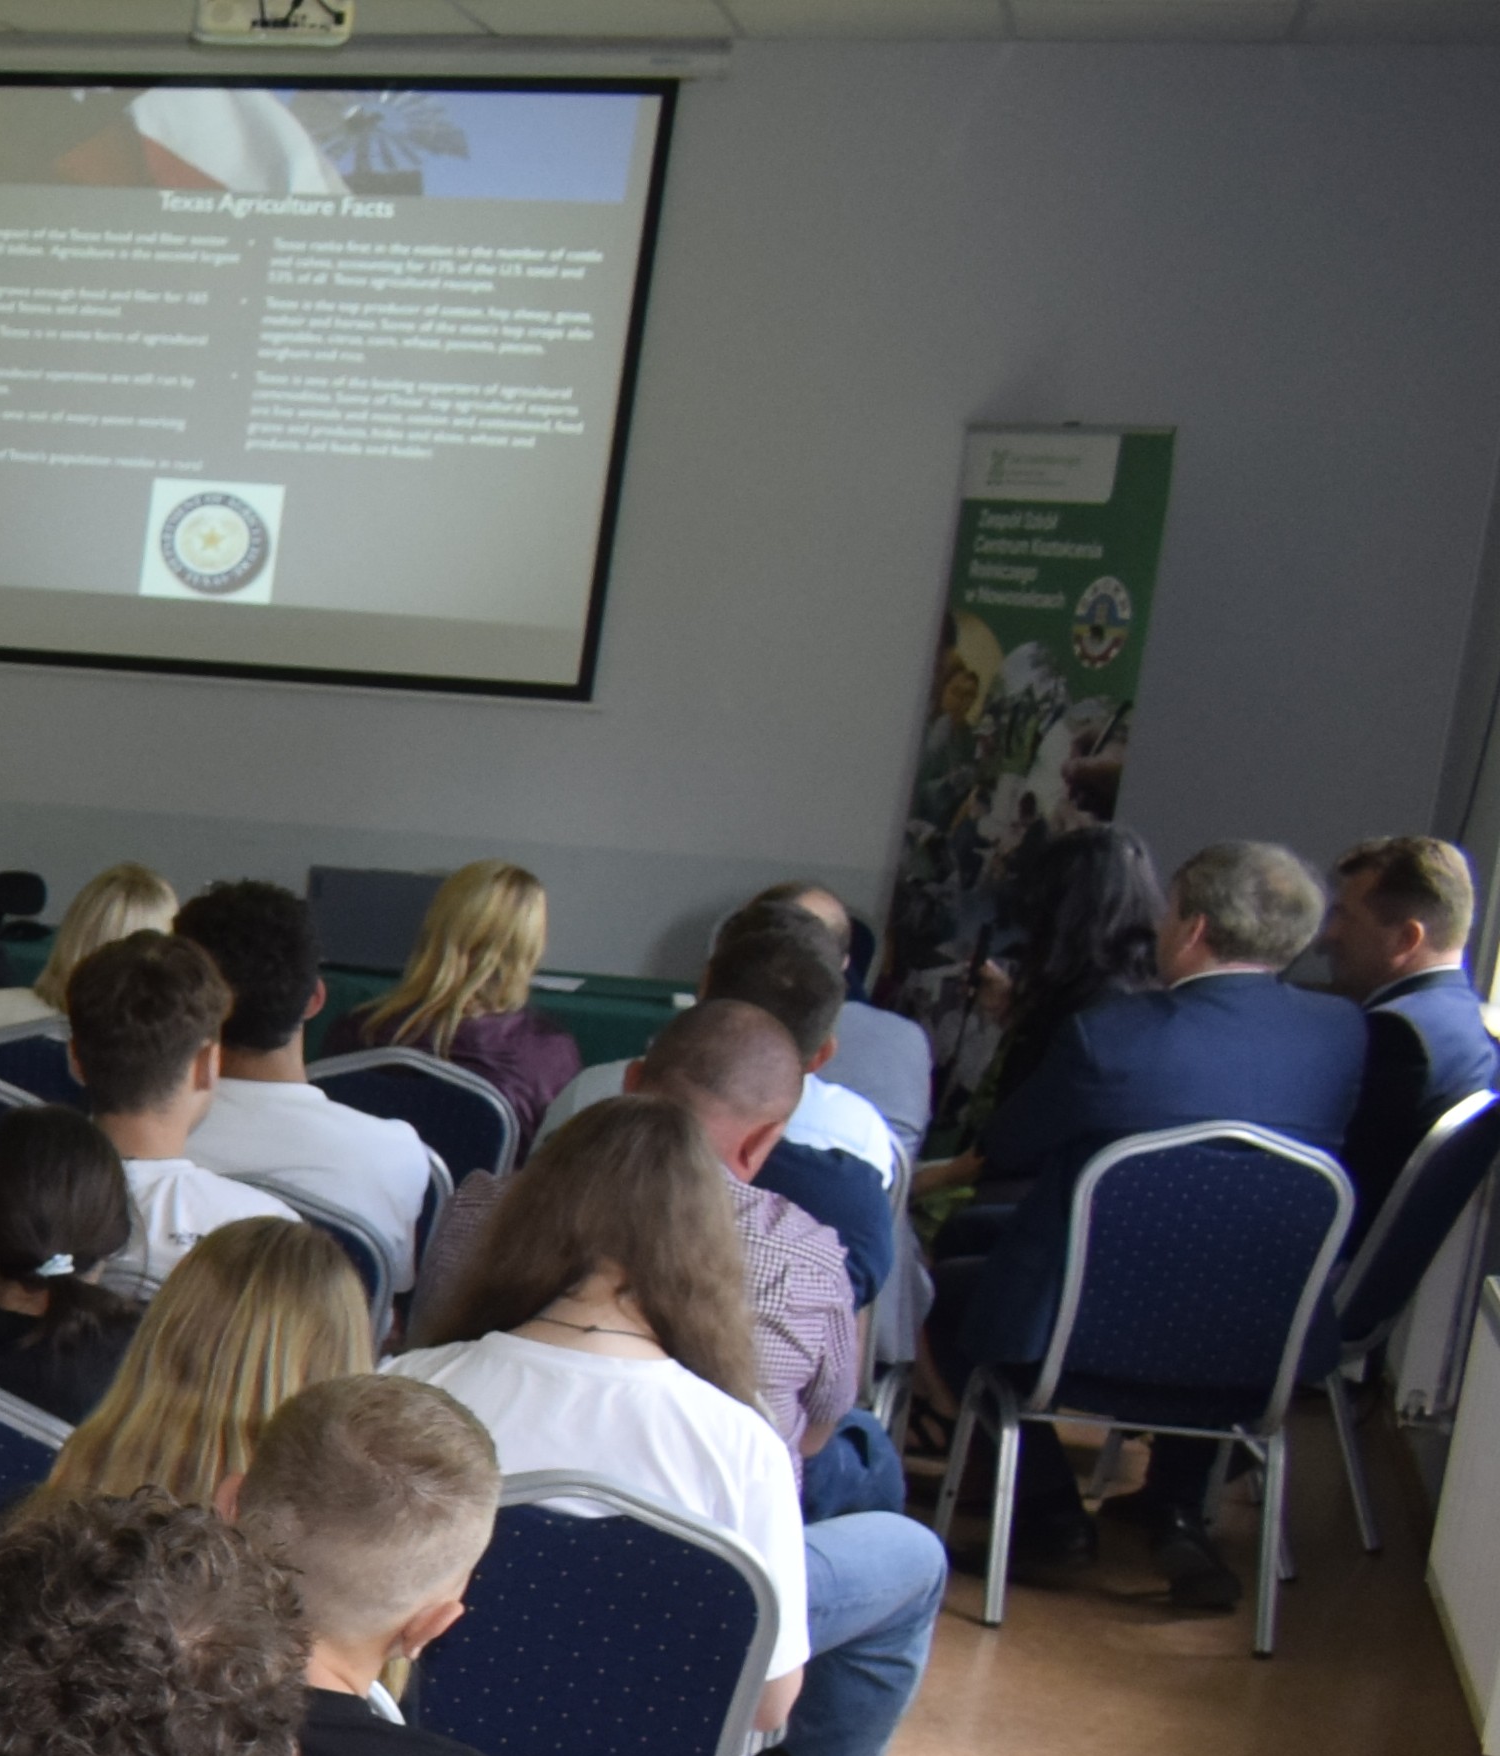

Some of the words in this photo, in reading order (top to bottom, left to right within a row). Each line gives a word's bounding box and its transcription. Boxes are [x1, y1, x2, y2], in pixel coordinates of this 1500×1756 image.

[158, 190, 214, 213] Texas
[218, 192, 336, 219] Agriculture
[341, 195, 396, 219] Facts
